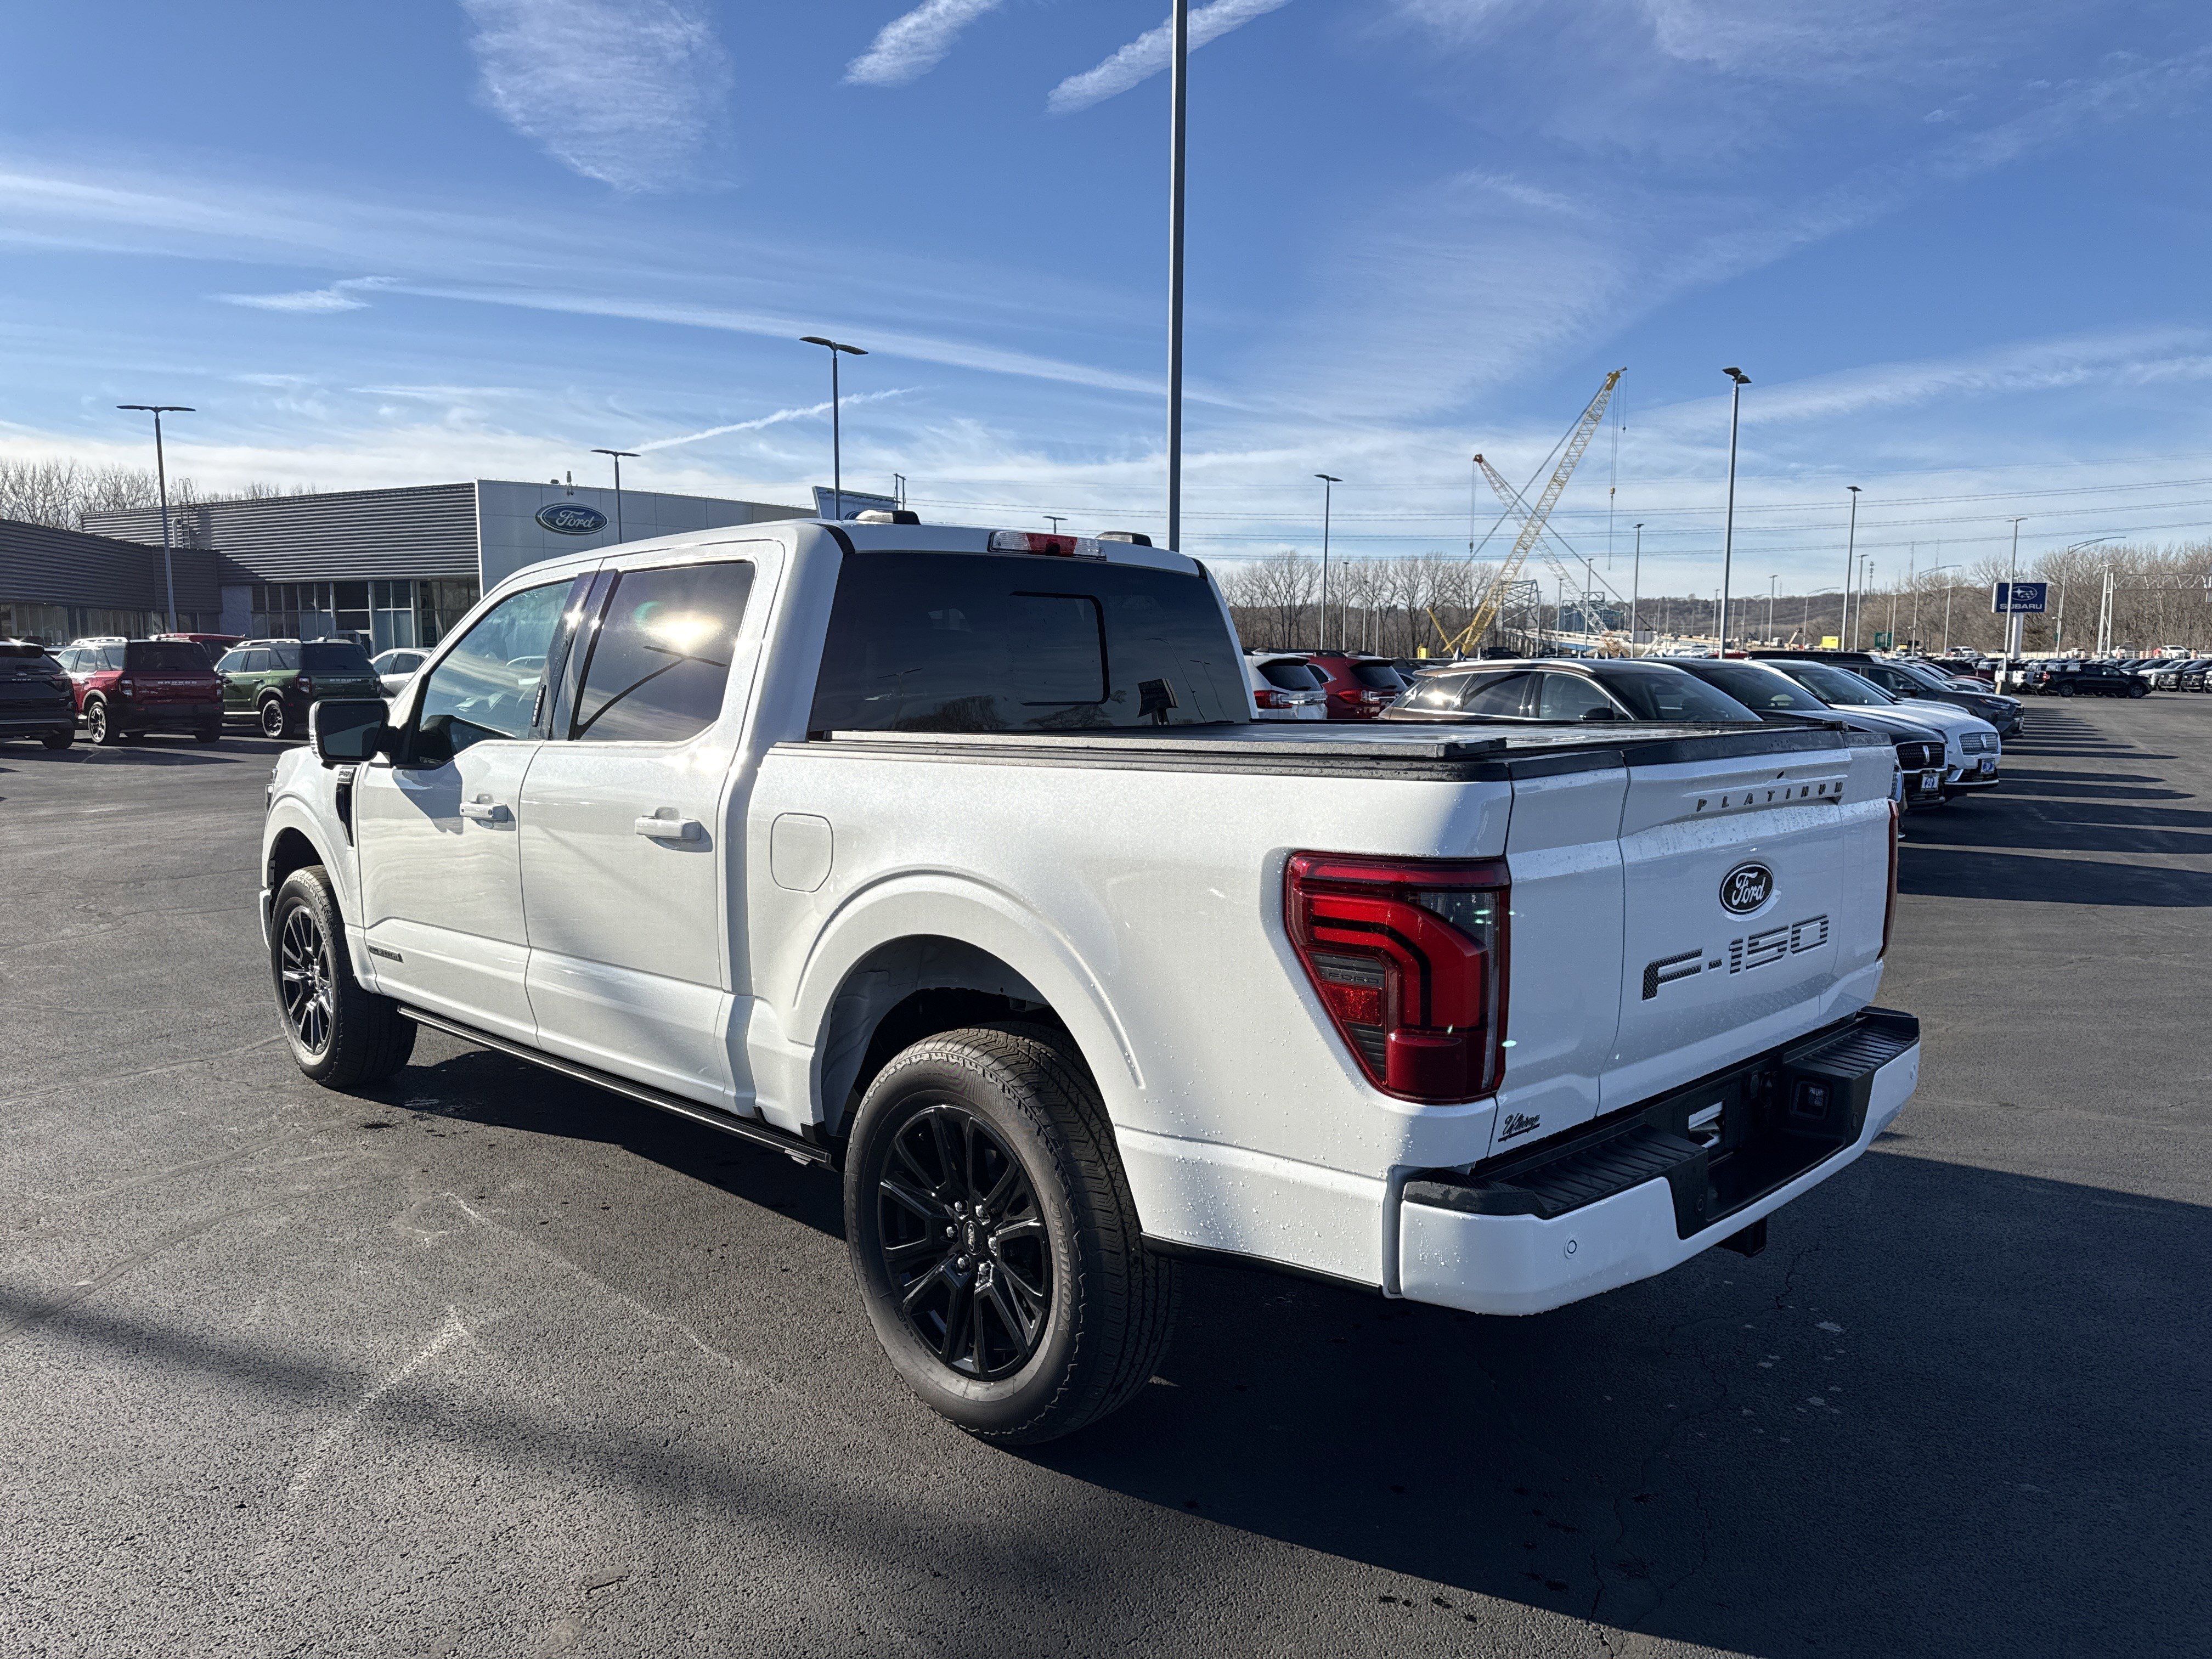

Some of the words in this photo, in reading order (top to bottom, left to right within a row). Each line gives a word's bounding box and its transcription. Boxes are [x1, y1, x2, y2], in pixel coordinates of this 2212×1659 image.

[556, 510, 595, 528] Ford
[1696, 781, 1843, 812] PLATINUM
[1732, 872, 1765, 906] Ford
[1642, 915, 1829, 1000] F-150
[1329, 973, 1380, 984] FORD
